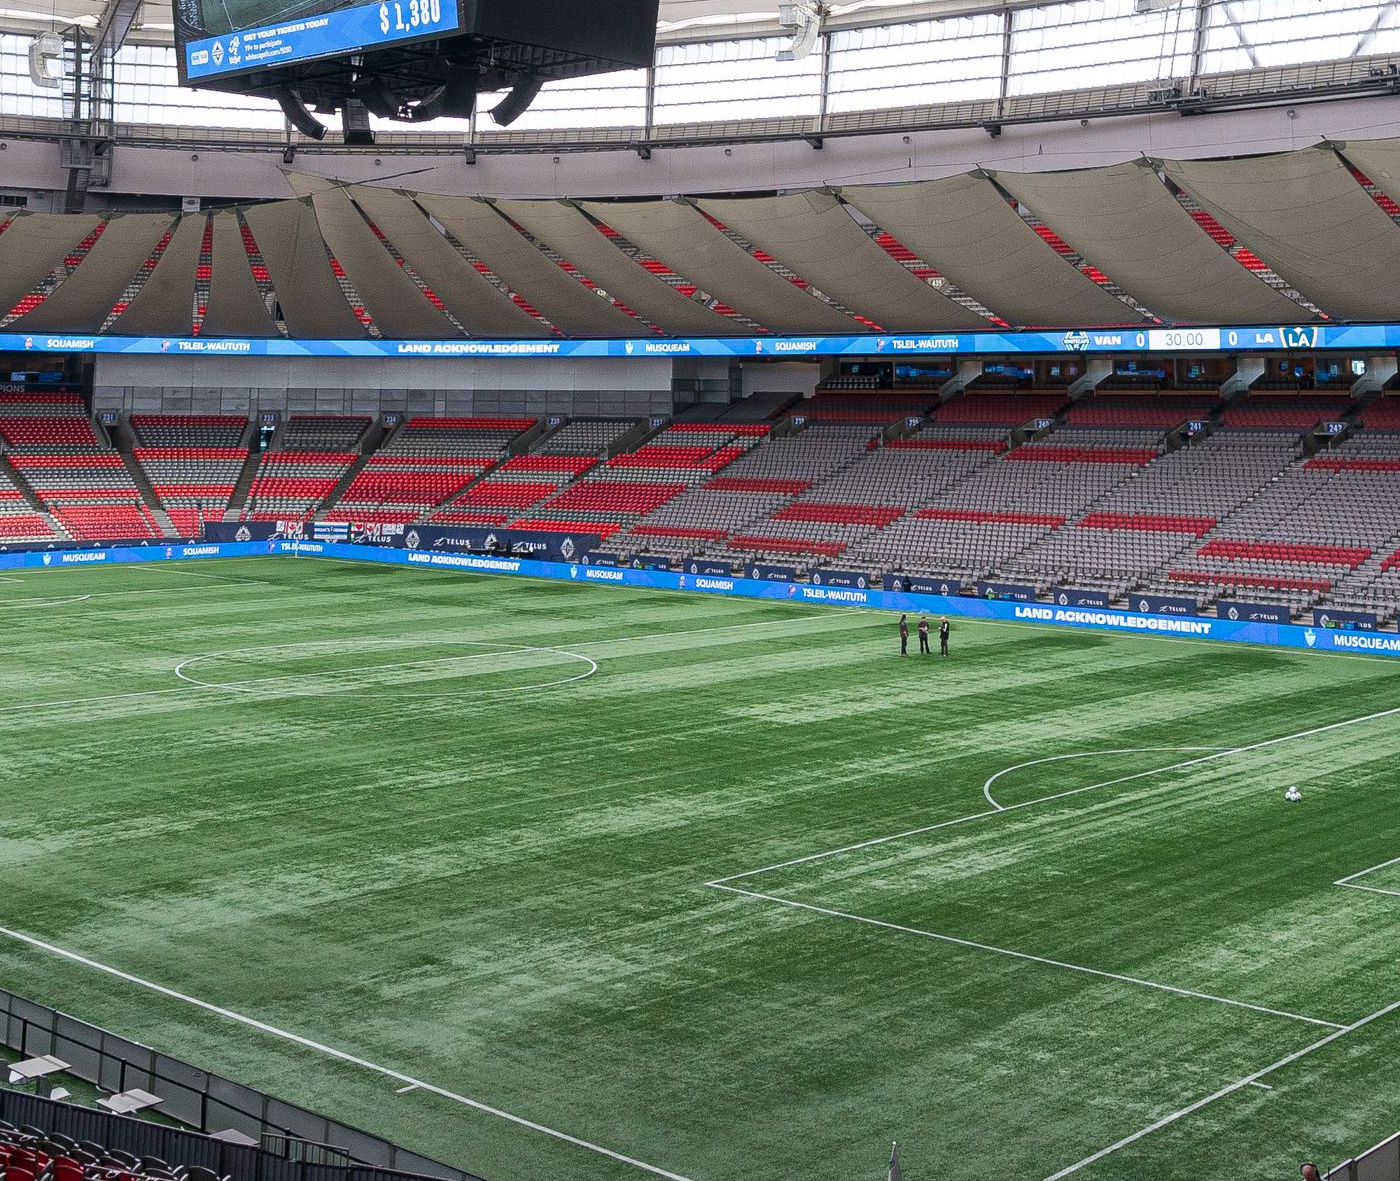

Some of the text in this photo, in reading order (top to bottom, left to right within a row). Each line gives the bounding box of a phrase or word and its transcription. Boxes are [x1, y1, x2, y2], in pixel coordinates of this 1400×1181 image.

[380, 2, 389, 34] $
[1094, 332, 1145, 348] VAN 0
[1165, 333, 1203, 346] 30:00
[1228, 331, 1275, 346] 0 LA
[47, 339, 94, 349] SQUAMISH
[178, 341, 251, 351] TSLEIL-WAUTUTH
[398, 344, 560, 354] LAND ACKNOWLEDGEMENT
[645, 343, 690, 352] MUSQUEAM
[775, 341, 816, 351] SQUAMISH
[892, 339, 959, 349] TSLEIL-WAUTUTH
[1190, 422, 1203, 432] 241
[368, 535, 392, 543] TELUS
[446, 538, 470, 547] TELUS
[183, 546, 220, 556] SQUAMISH
[62, 552, 106, 562] MUSQUEAM
[408, 553, 521, 571] LAND ACKNOWLEDGEMENT
[586, 569, 623, 580] MUSQUEAM
[695, 578, 733, 590] SQUAMISH
[802, 588, 867, 603] TSLEIL-WAUTUTH
[1015, 606, 1212, 635] LAND ACKNOWLEDGEMENT
[1334, 635, 1400, 651] MUSQUEAM
